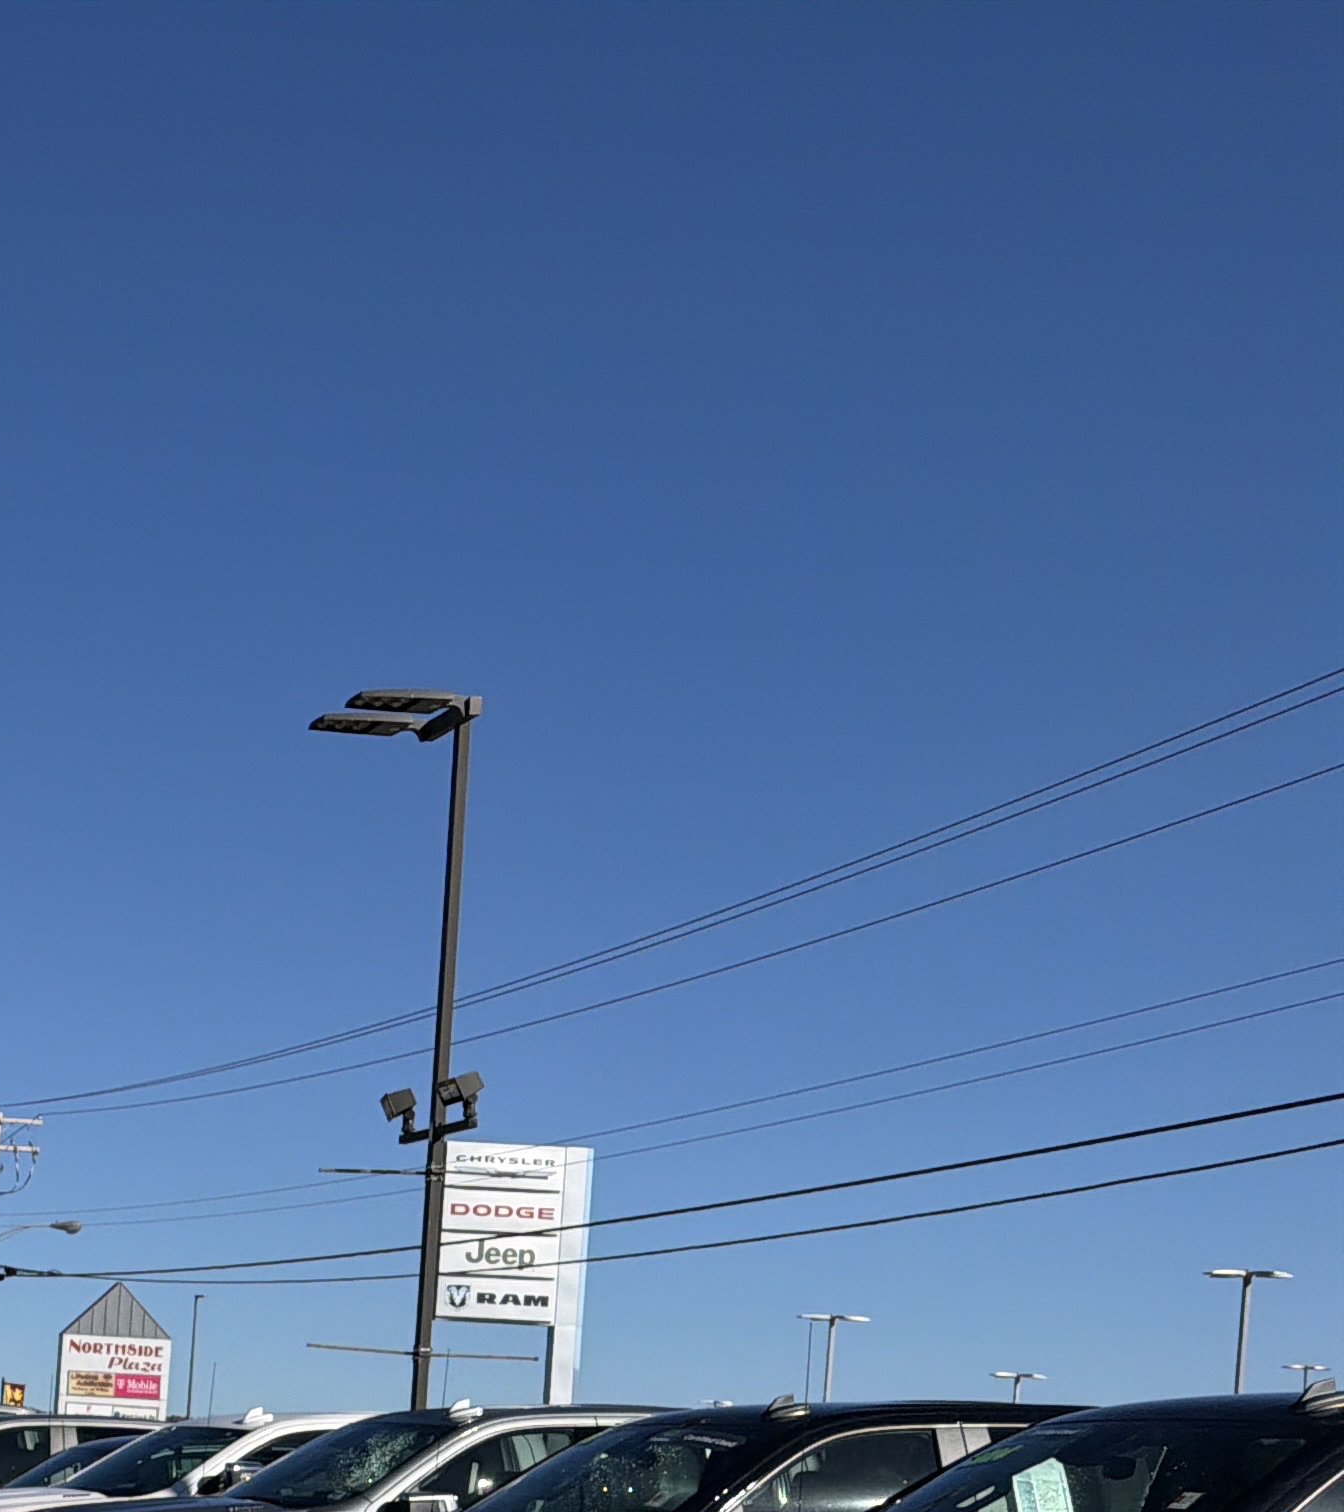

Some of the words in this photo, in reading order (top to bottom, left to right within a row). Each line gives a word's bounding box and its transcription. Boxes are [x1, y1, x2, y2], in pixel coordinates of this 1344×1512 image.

[455, 1154, 556, 1167] CHRYSLER
[450, 1203, 555, 1220] DODGE
[465, 1239, 536, 1269] Jeep
[476, 1292, 550, 1307] RAM
[107, 1356, 163, 1372] Plaza
[126, 1378, 158, 1391] Mobile
